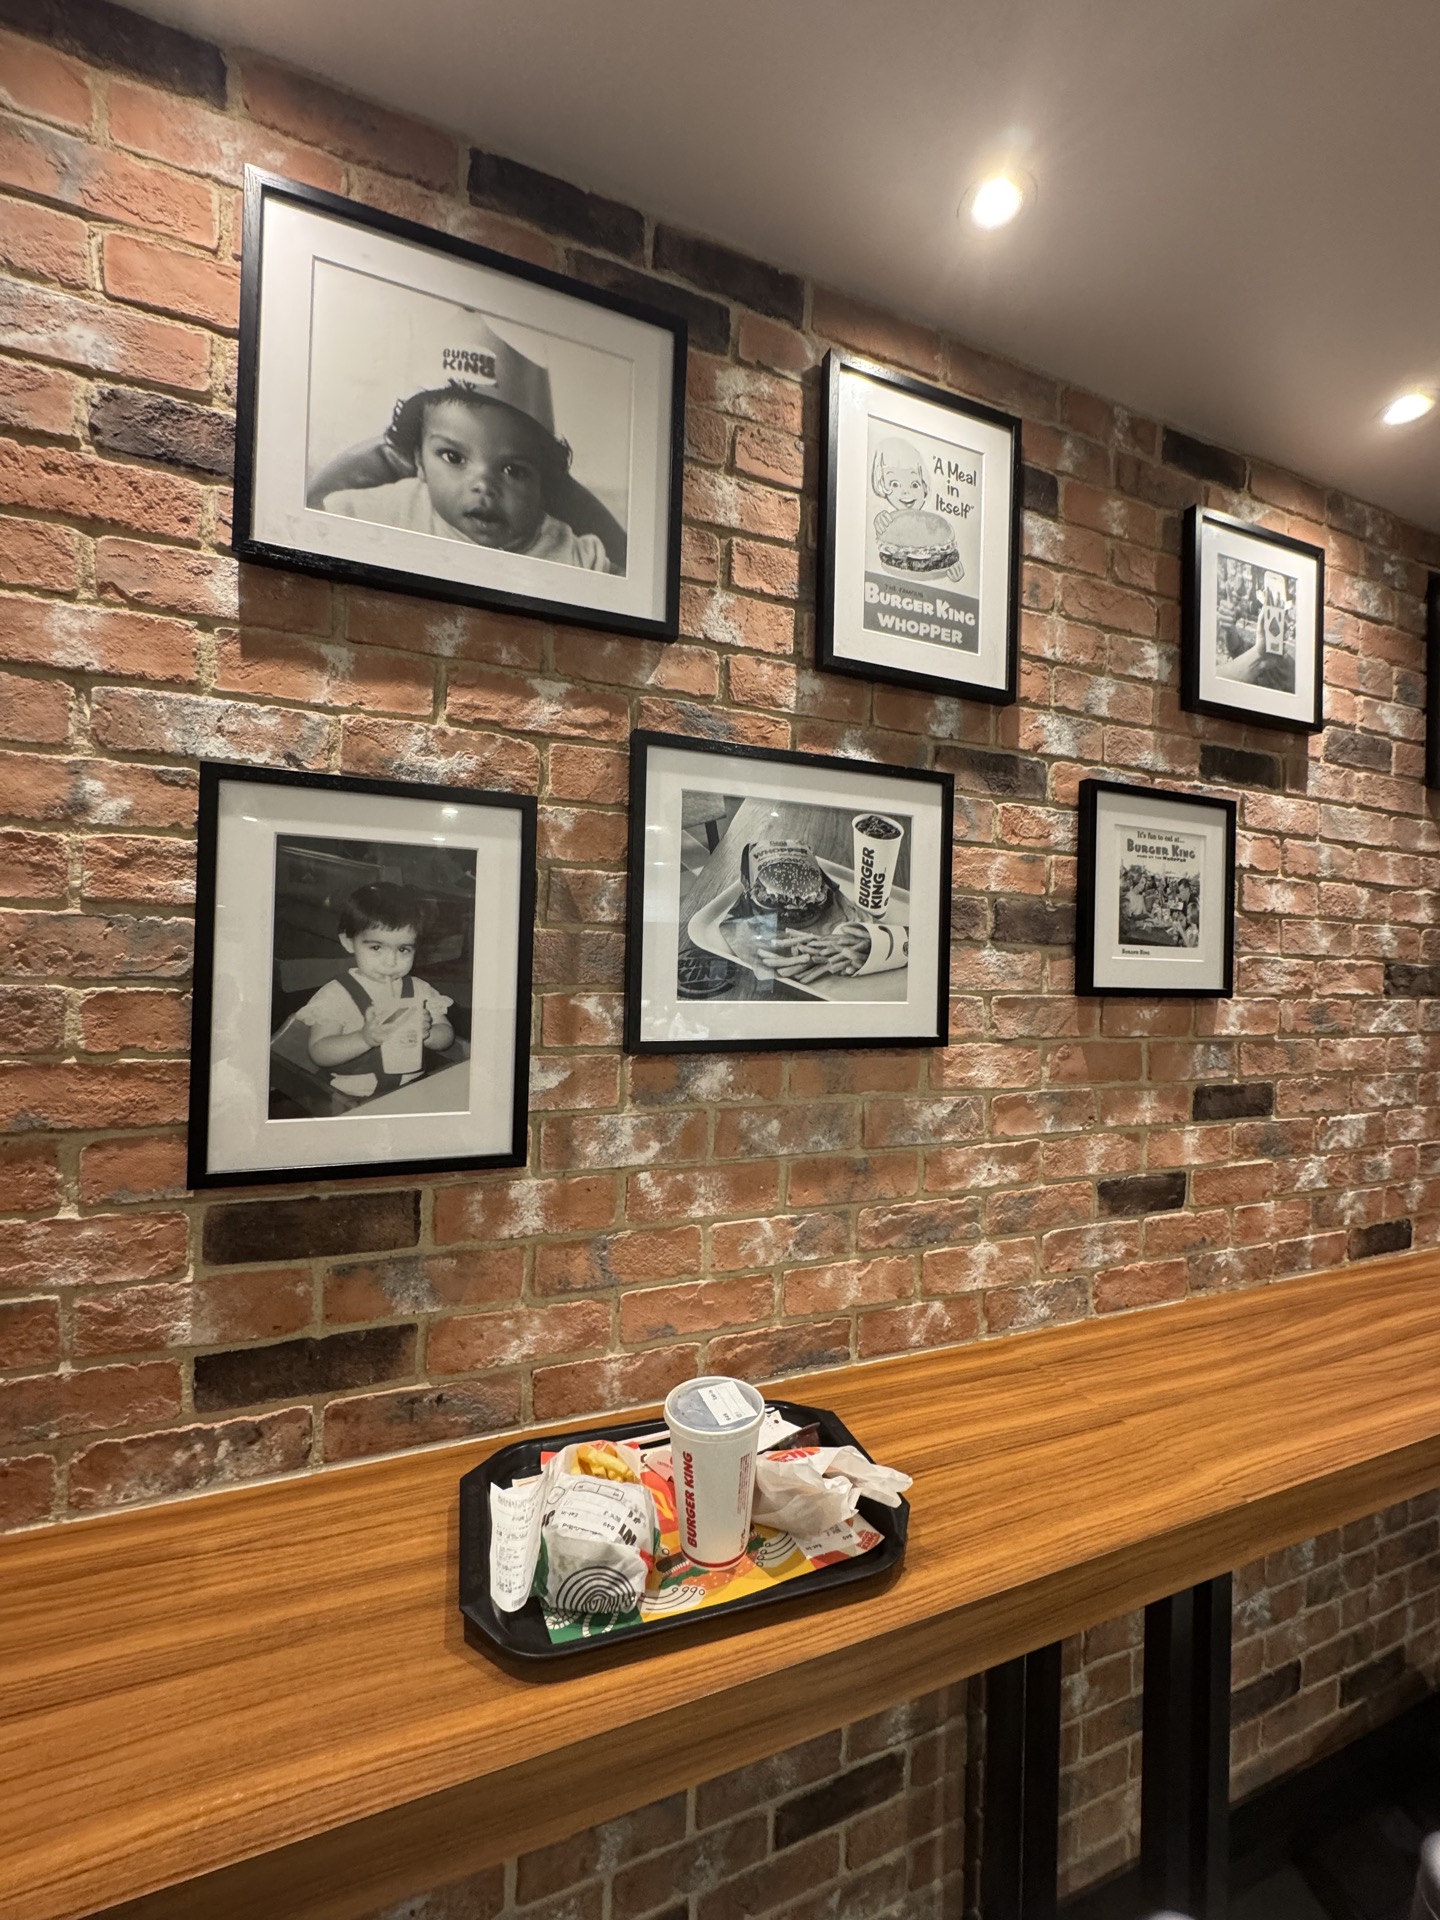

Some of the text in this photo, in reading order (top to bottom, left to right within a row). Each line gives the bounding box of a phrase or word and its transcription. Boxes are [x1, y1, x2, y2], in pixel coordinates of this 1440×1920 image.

[443, 359, 496, 379] KING
[947, 460, 977, 487] Meal
[947, 479, 959, 498] in
[864, 581, 976, 626] BURGER KING
[877, 611, 963, 644] WHOPPER
[1127, 838, 1195, 859] BURGER KING
[1137, 830, 1146, 839] It's
[1147, 832, 1157, 840] fun
[858, 846, 875, 908] BURGER
[870, 872, 886, 909] KING
[682, 1451, 697, 1549] BURGER KING
